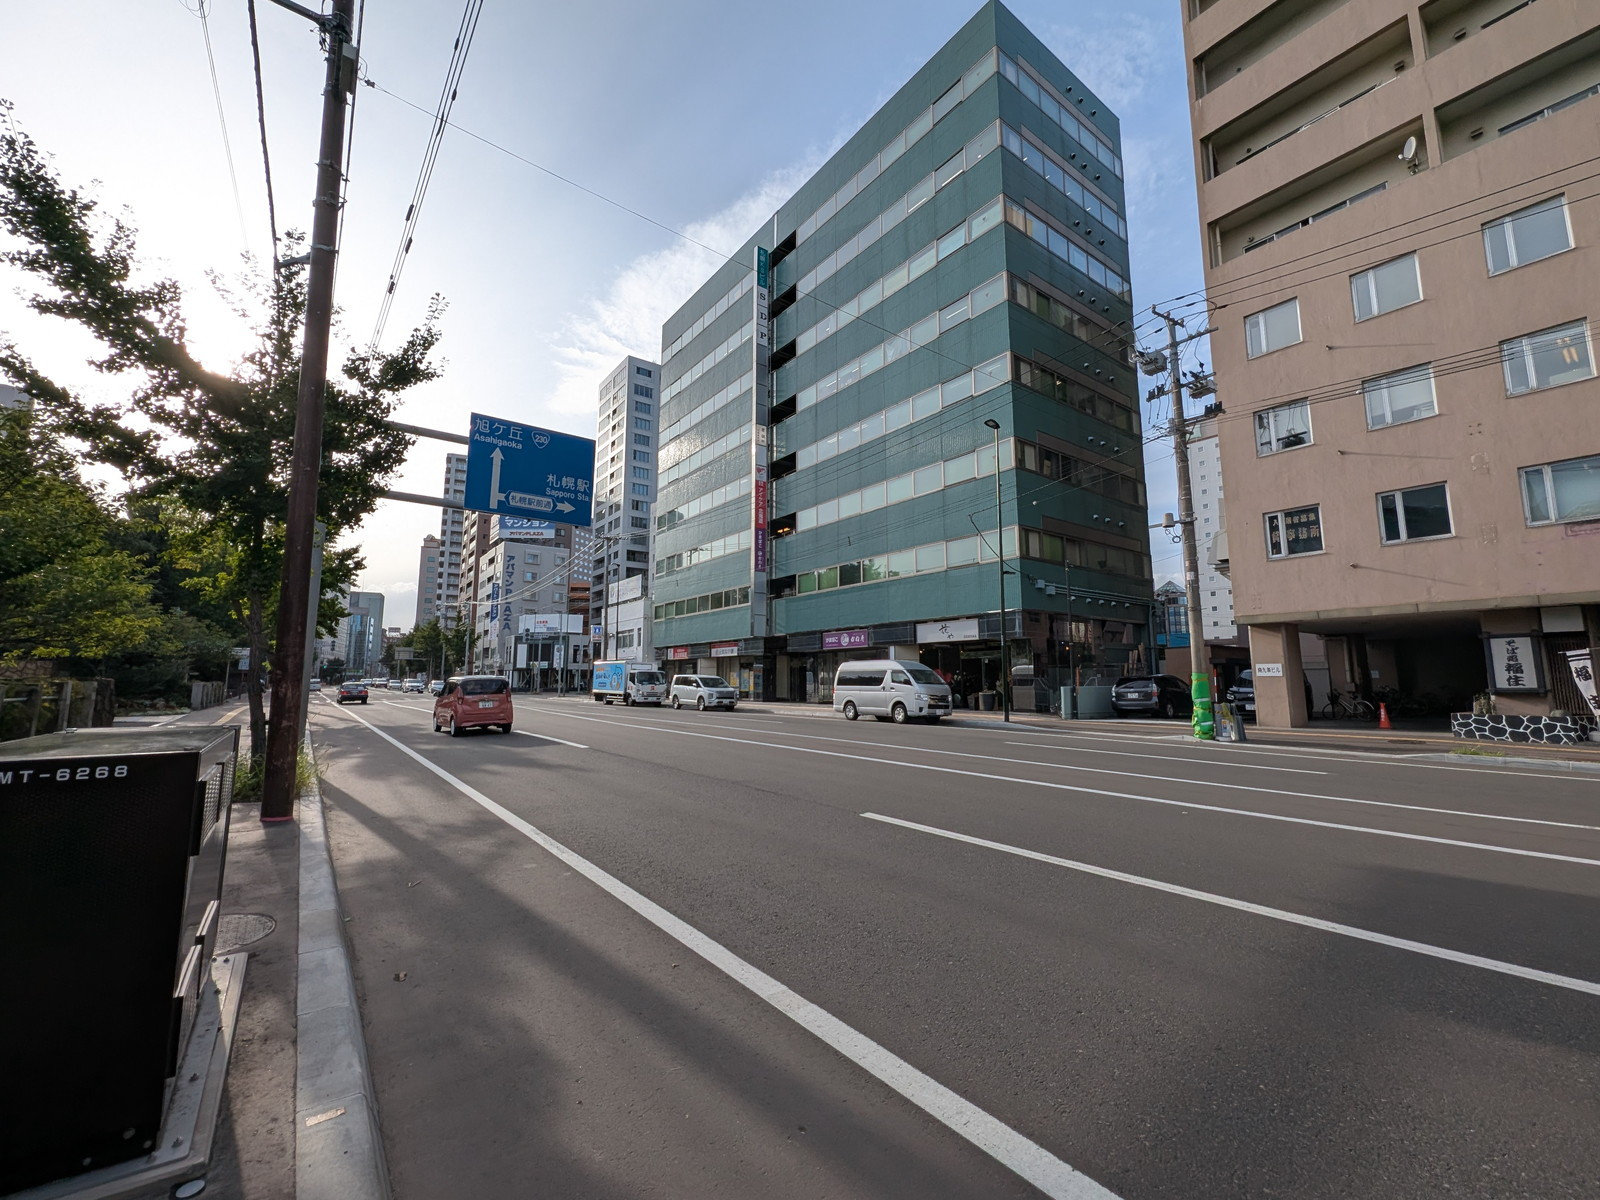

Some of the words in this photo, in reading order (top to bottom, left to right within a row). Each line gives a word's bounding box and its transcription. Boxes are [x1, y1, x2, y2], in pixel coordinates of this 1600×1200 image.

[474, 433, 523, 450] Asahigaoka
[534, 434, 548, 444] 230
[547, 473, 590, 493] 札幌駅
[545, 487, 575, 500] Sapporo
[510, 494, 552, 509] 札幌駅前通
